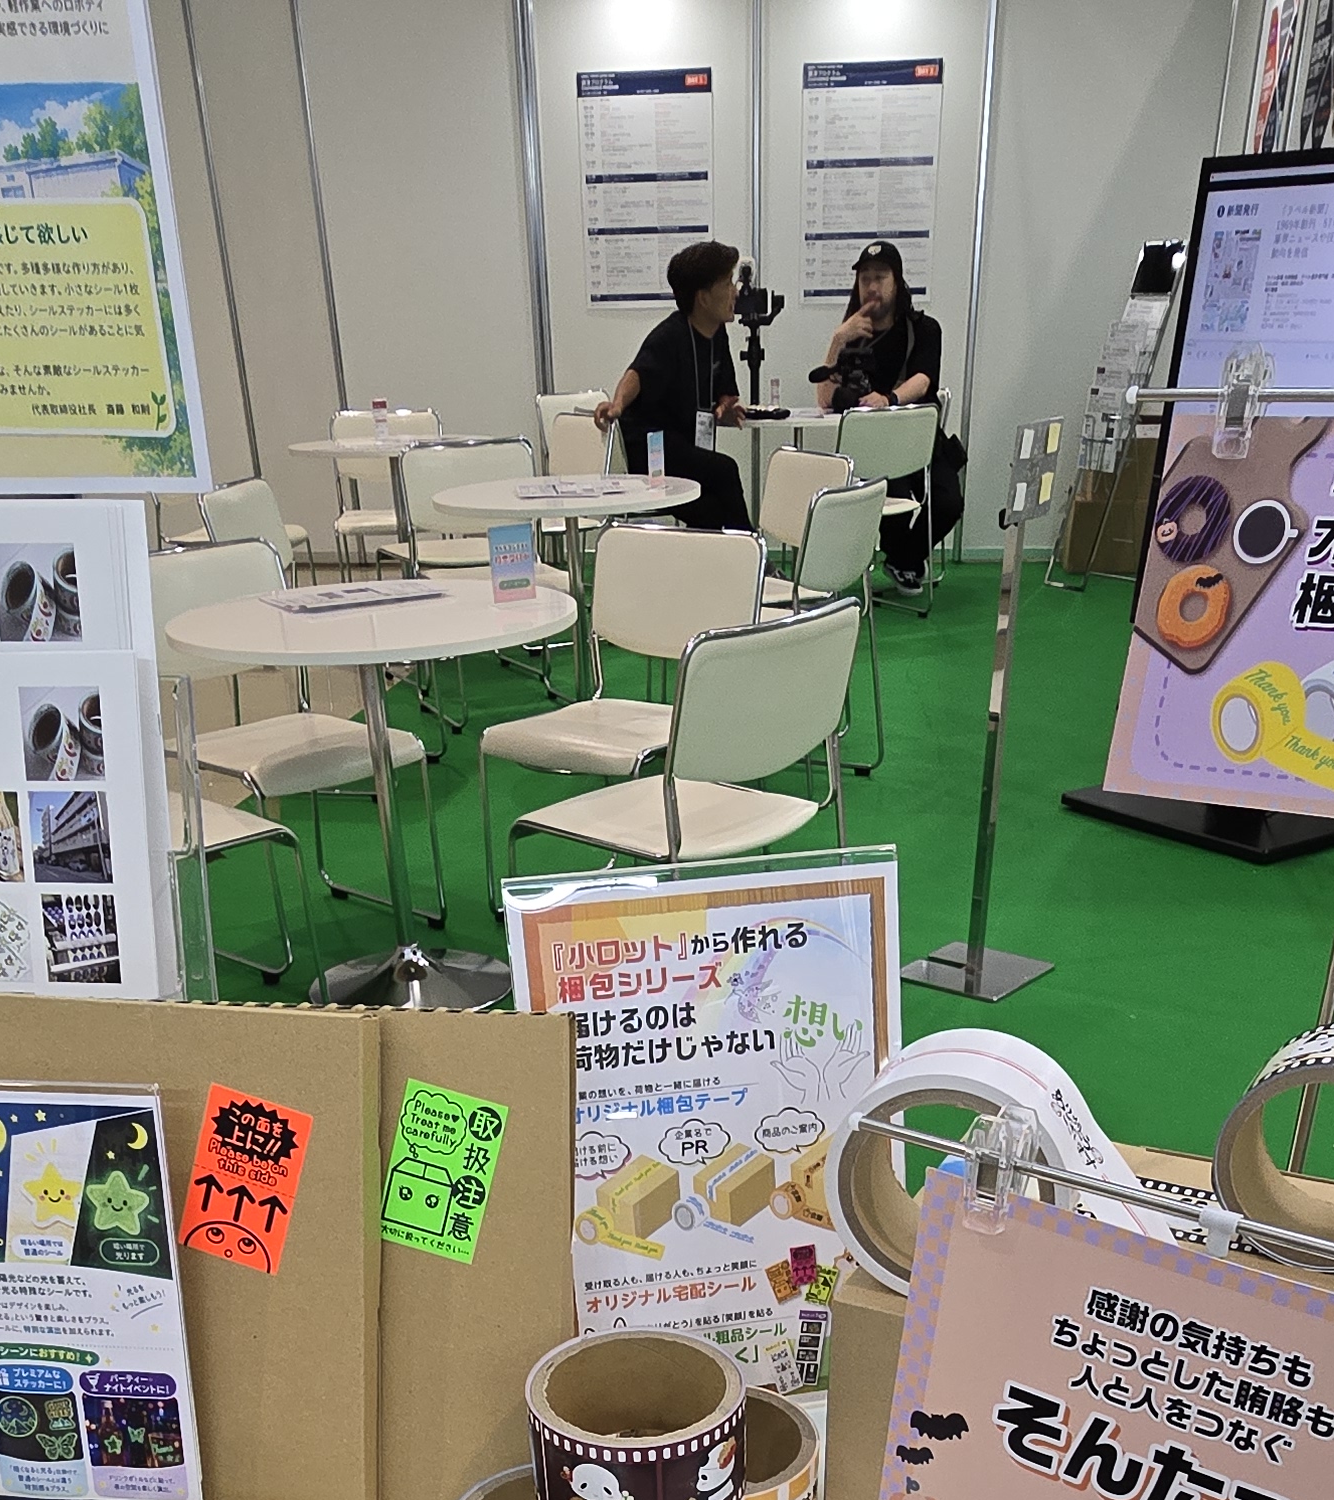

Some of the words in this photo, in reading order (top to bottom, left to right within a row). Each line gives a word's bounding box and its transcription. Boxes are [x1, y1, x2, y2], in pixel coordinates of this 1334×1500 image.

[1244, 668, 1279, 705] Thank
[1271, 700, 1293, 727] you
[1284, 735, 1320, 761] Thank
[552, 922, 809, 972] 『小ロット』から作れる
[558, 963, 723, 1003] 梱包シリーズ
[784, 994, 863, 1048] 想い
[227, 1107, 284, 1138] この面を
[410, 1112, 441, 1131] Treat
[442, 1123, 457, 1134] me
[413, 1099, 451, 1122] Please
[405, 1125, 458, 1149] carefully
[674, 1127, 712, 1141] 企業名で
[762, 1121, 818, 1138] 商品のご案内
[208, 1139, 250, 1163] Please
[681, 1140, 709, 1156] PR
[218, 1157, 246, 1178] this
[249, 1166, 278, 1187] side
[447, 1108, 502, 1243] 取扱注意
[586, 1279, 758, 1315] オリジナル宅配シール
[1086, 1289, 1312, 1388] 感謝の気持ちも
[1071, 1363, 1295, 1464] 人と人をつなぐ
